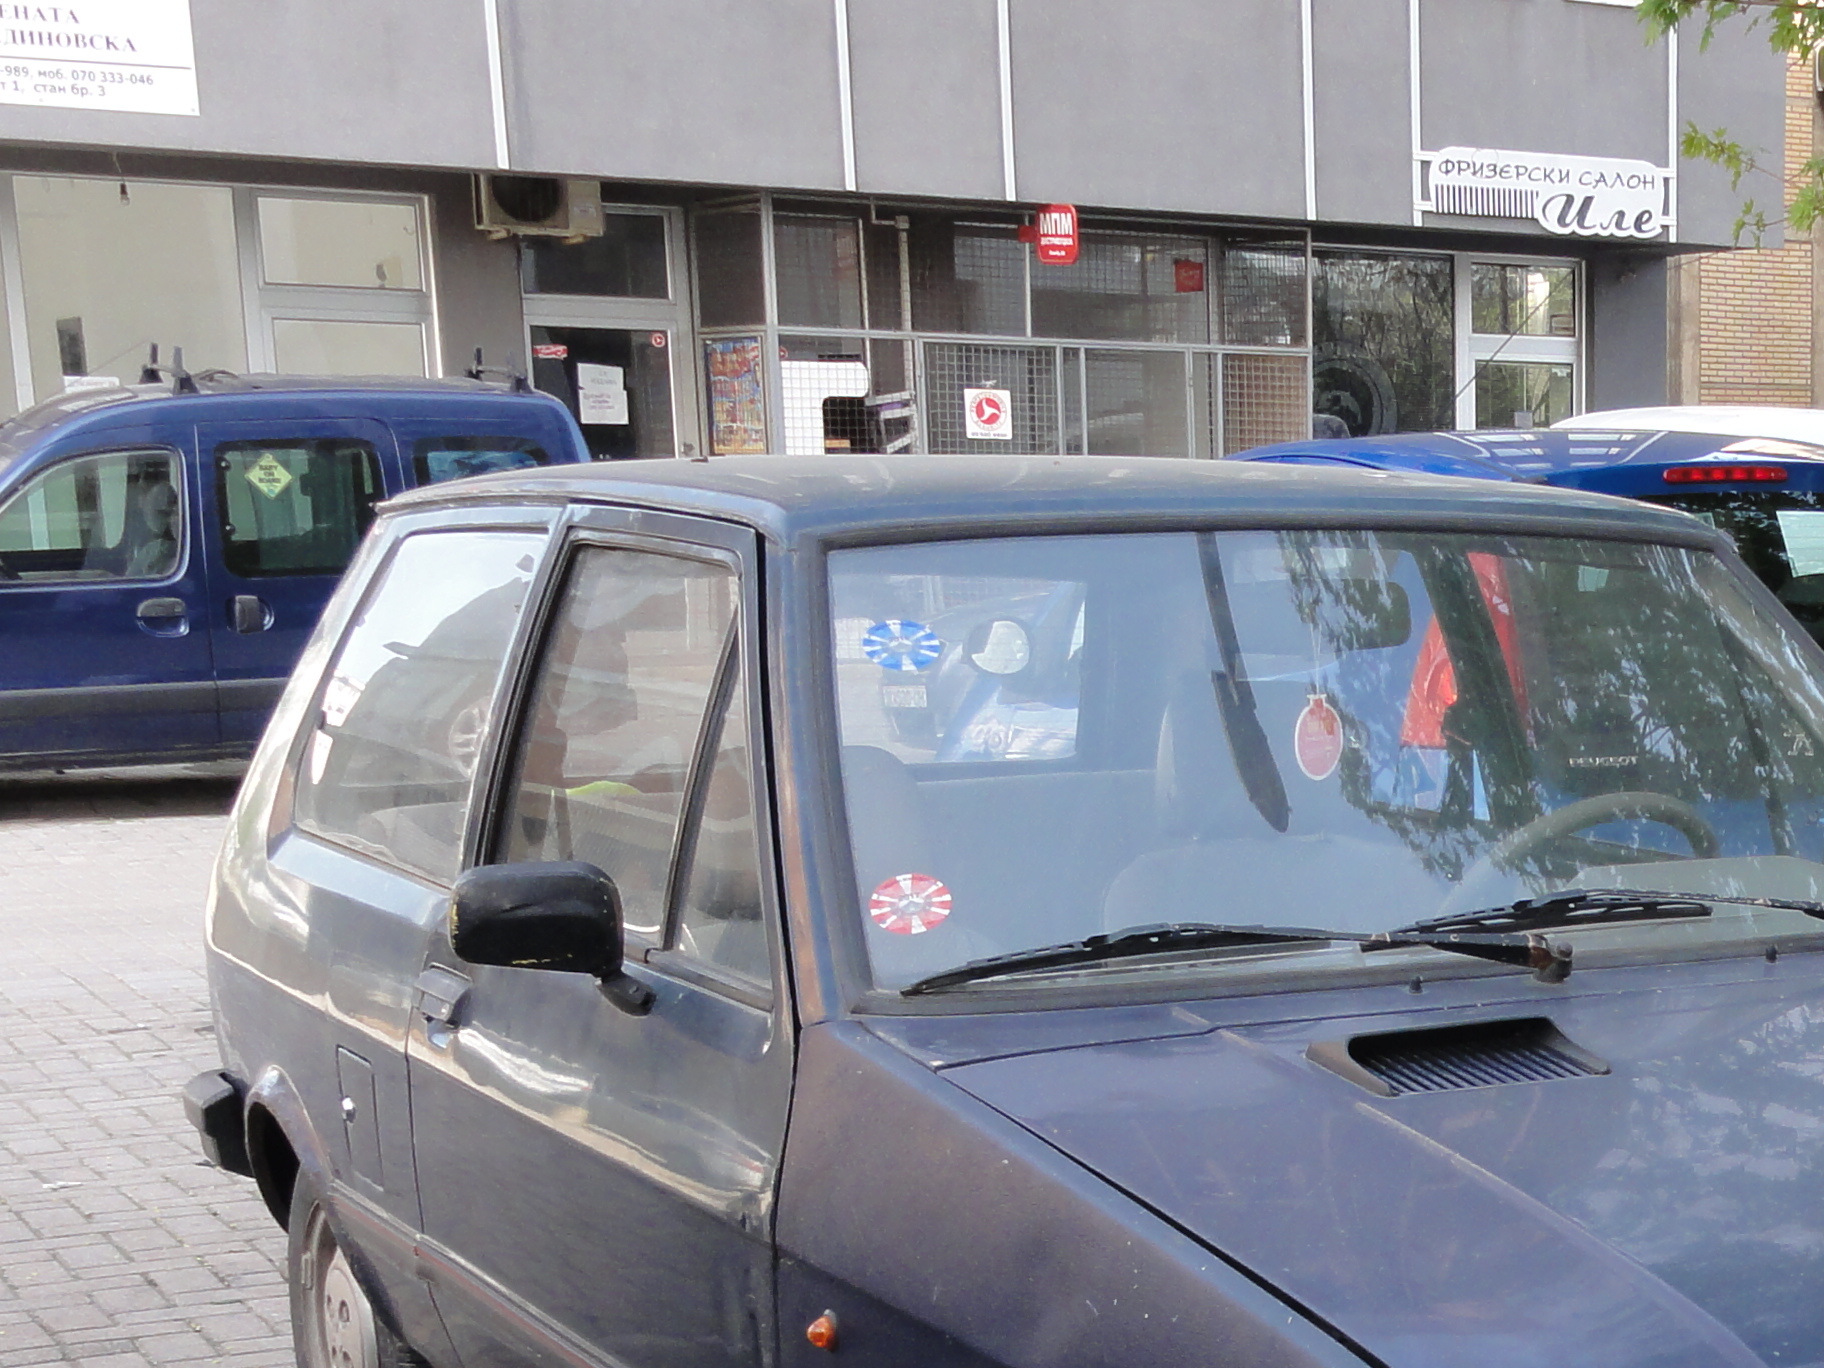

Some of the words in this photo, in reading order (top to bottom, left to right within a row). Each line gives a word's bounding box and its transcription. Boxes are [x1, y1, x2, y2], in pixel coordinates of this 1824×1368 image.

[0, 28, 137, 52] ДИНОВСКА
[71, 69, 96, 82] 070
[100, 71, 154, 86] 333-046
[33, 83, 67, 95] стан
[97, 84, 106, 97] 3
[1578, 170, 1655, 191] САЛОН
[1039, 212, 1073, 236] МПМ
[1541, 193, 1657, 234] Иле
[1568, 756, 1638, 768] PEUGEOT
